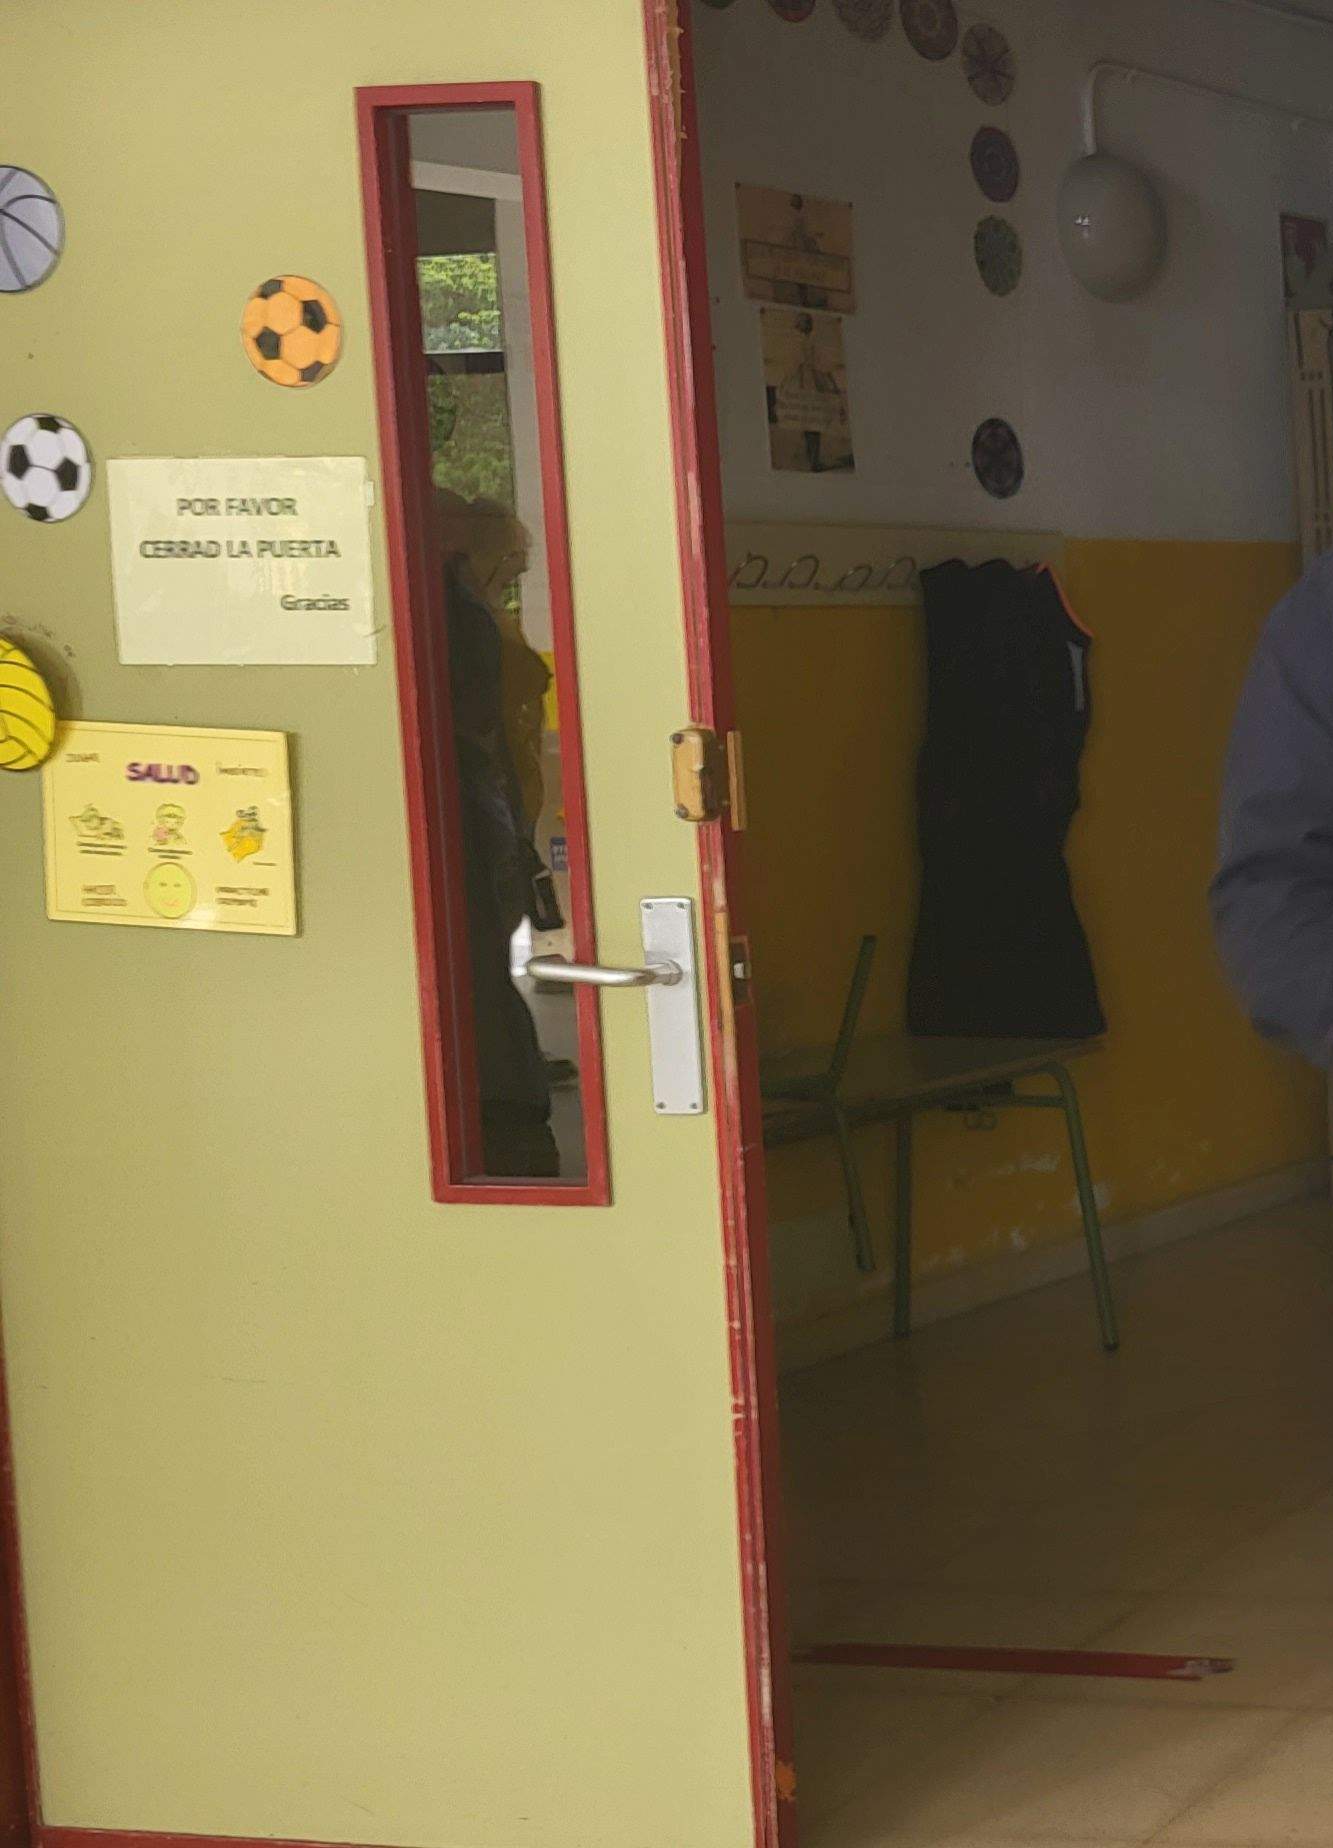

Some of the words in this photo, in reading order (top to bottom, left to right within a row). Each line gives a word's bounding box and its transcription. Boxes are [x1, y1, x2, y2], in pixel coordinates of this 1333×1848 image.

[176, 497, 221, 516] POR
[225, 497, 299, 516] FAVOR
[139, 540, 221, 558] CERRAD
[226, 540, 253, 558] LA
[257, 540, 342, 558] PUERTA
[280, 594, 350, 611] Gracias
[125, 762, 199, 786] SALUD
